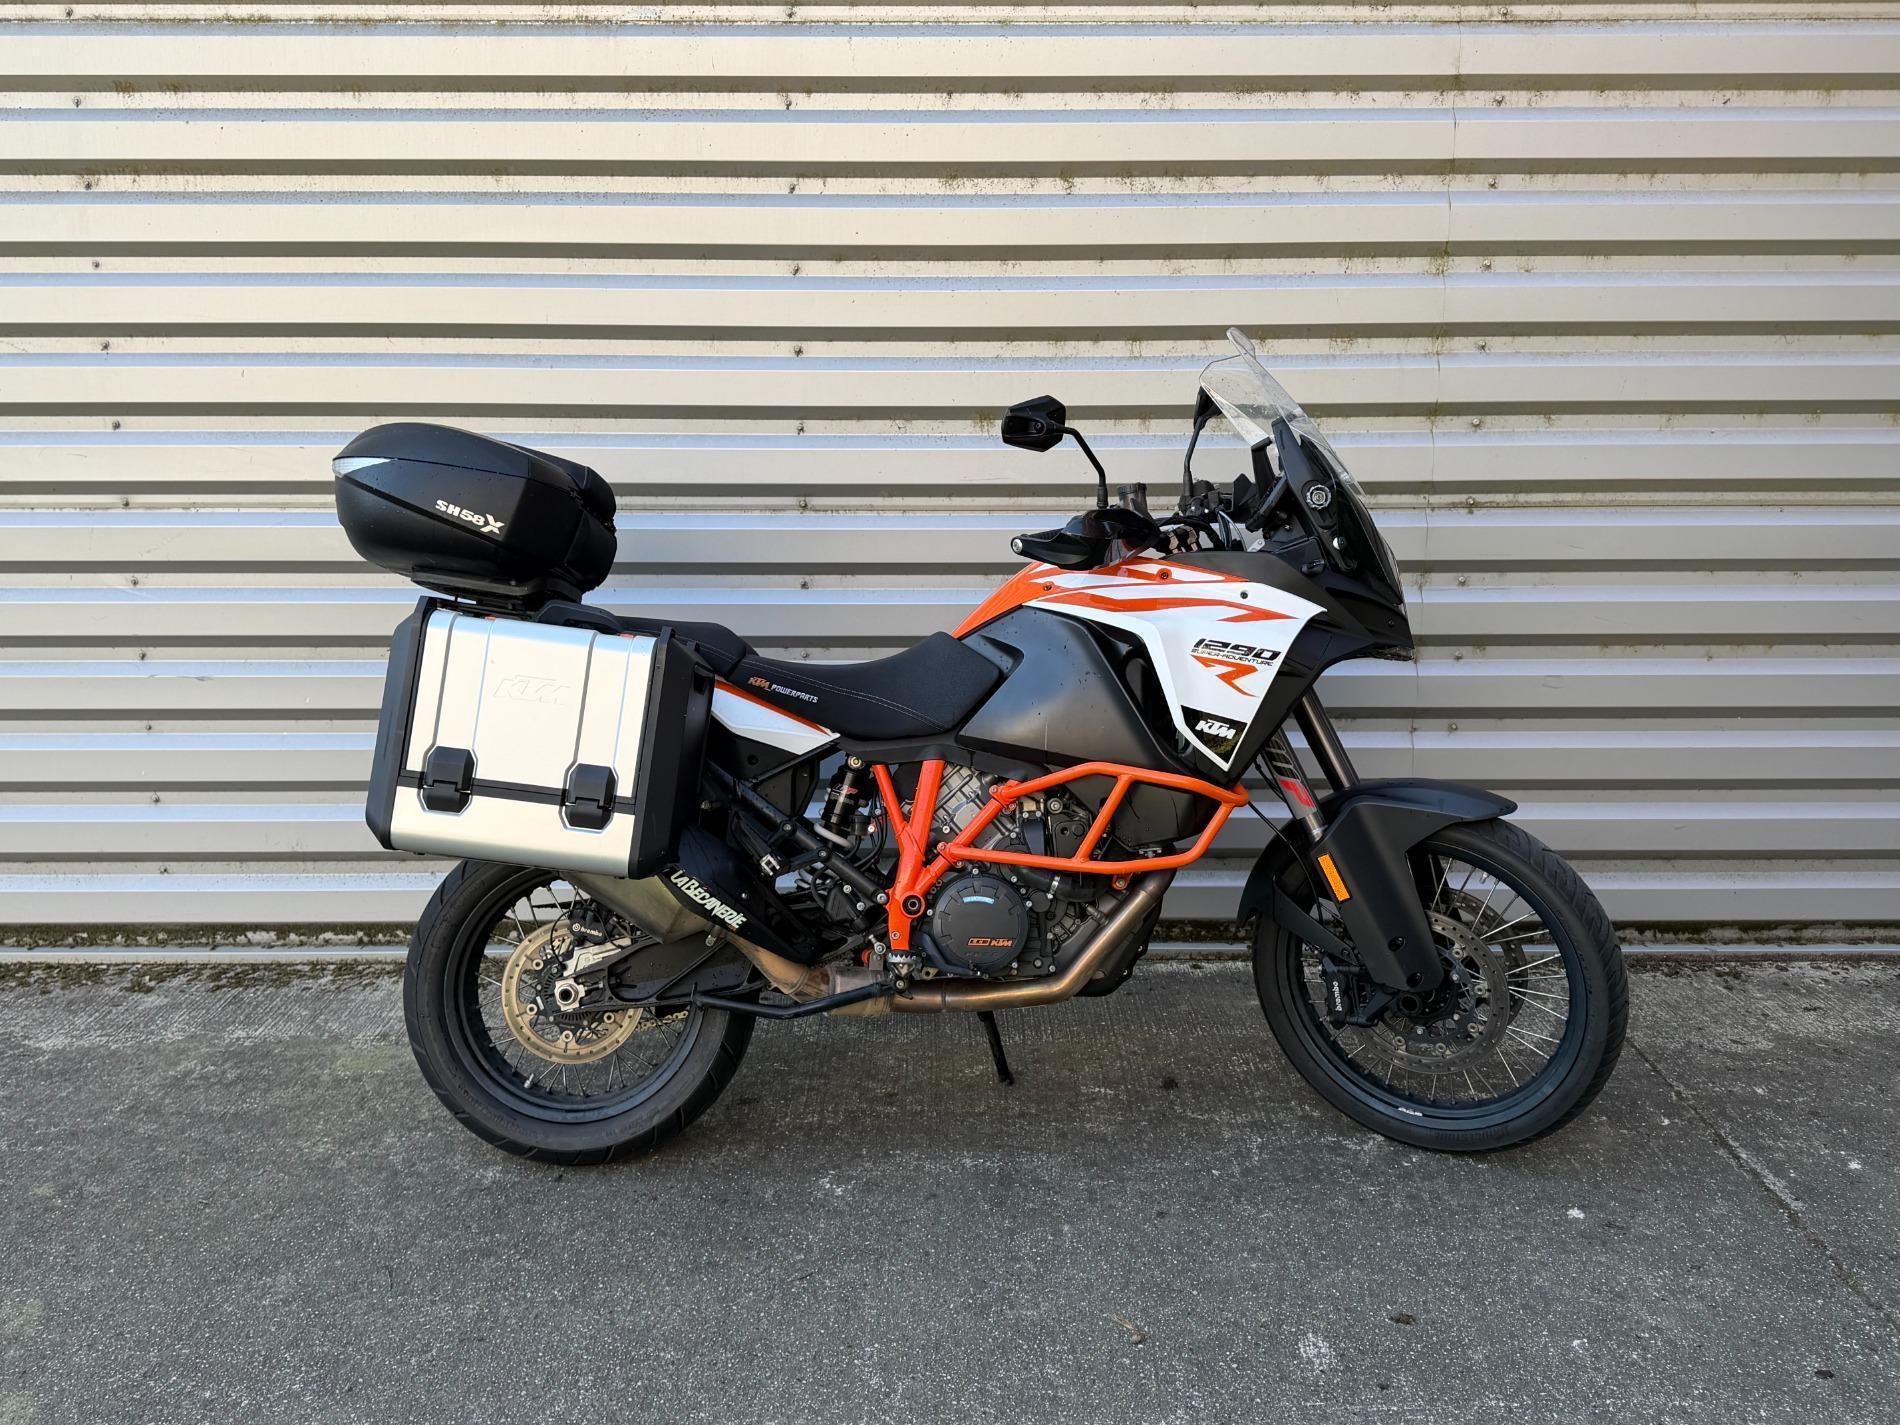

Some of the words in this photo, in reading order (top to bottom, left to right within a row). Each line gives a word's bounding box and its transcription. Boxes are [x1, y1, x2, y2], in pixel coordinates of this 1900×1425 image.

[435, 499, 505, 535] SH58X
[1193, 638, 1282, 661] 1290
[771, 684, 819, 703] POWERPARTS
[1194, 719, 1237, 740] KTM
[1332, 980, 1343, 1012] brembo
